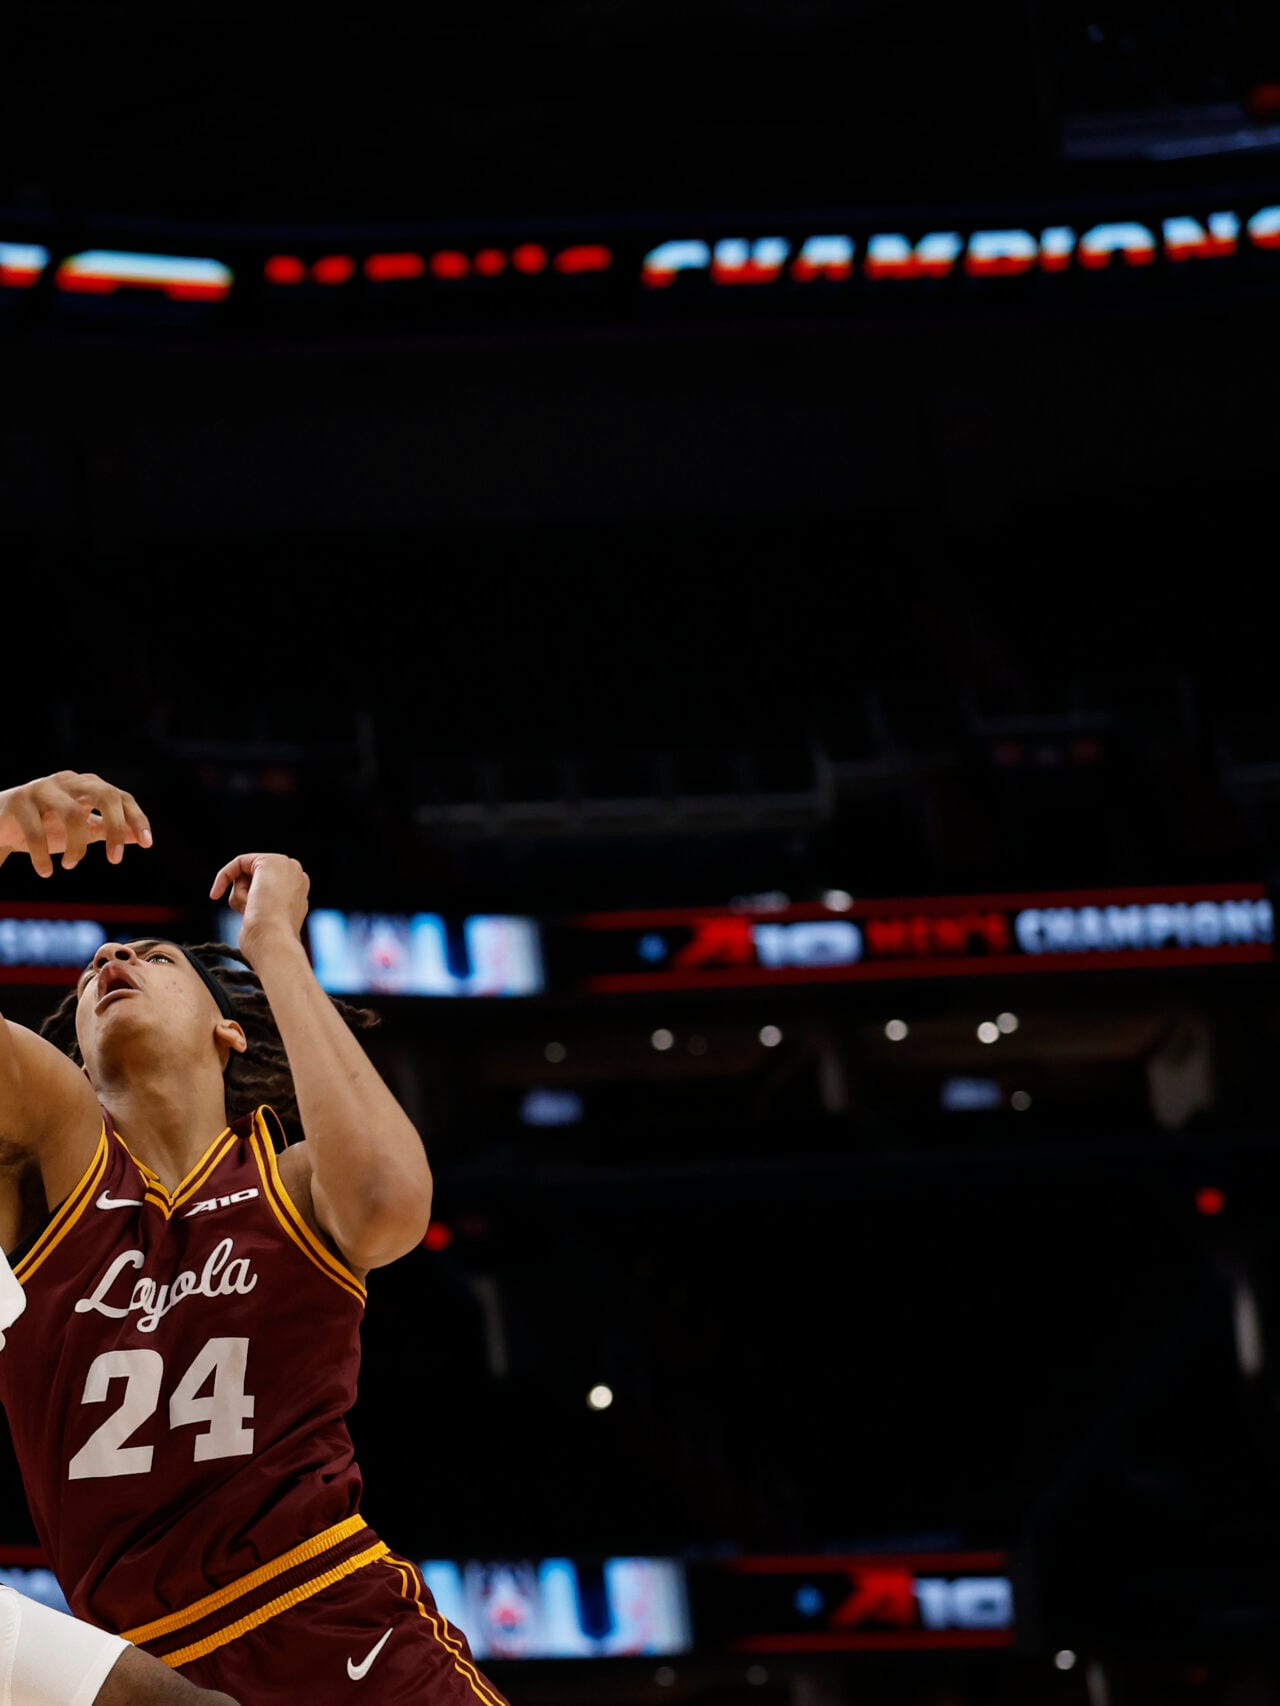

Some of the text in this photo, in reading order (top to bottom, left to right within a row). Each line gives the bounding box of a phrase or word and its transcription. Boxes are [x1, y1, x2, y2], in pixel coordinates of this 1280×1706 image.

[183, 1187, 260, 1218] A10
[74, 1237, 258, 1333] Loyola
[68, 1336, 255, 1481] 24
